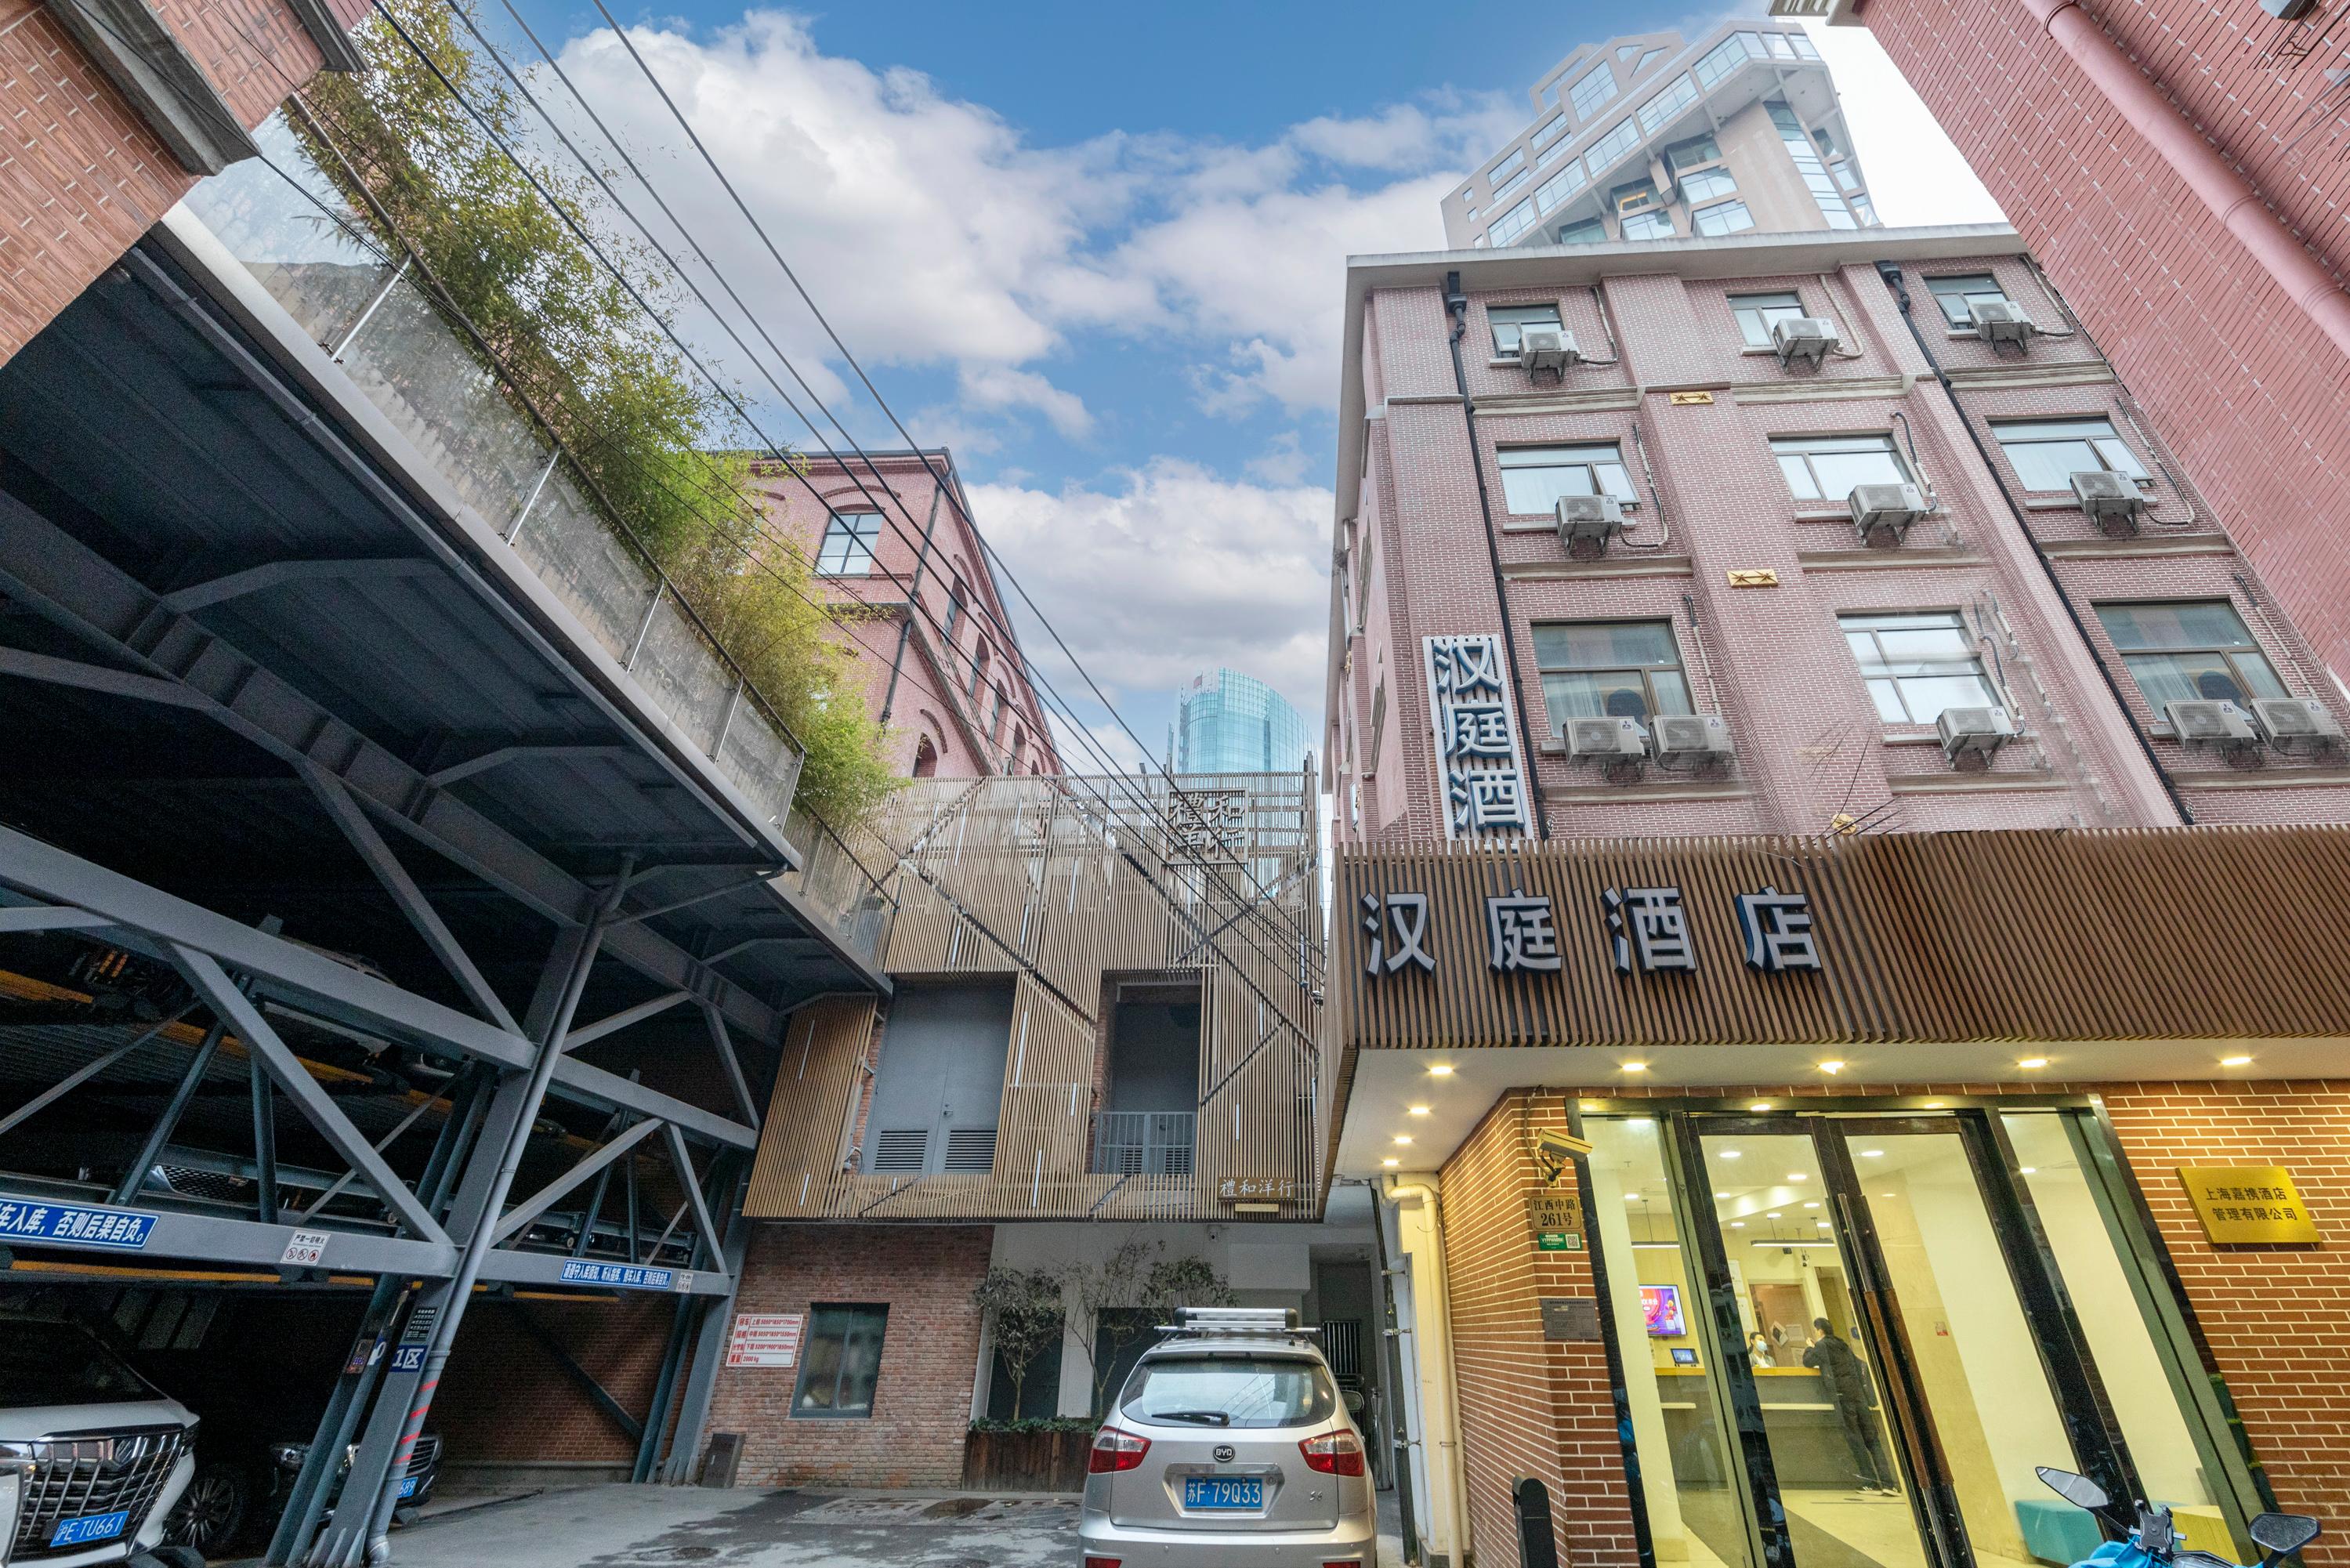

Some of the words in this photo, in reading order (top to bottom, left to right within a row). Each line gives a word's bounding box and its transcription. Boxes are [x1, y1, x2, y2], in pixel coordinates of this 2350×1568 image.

[1432, 639, 1526, 853] 汉庭酒
[1360, 885, 1822, 977] 汉庭酒店
[1219, 1178, 1294, 1197] 禮和洋行
[2206, 1187, 2287, 1201] 上海嘉携酒店
[1533, 1198, 1576, 1211] 江西中路
[0, 1204, 144, 1243] 车入库,否则后果自负。
[1541, 1212, 1573, 1226] 261号
[2212, 1208, 2297, 1221] 管理有限公司
[392, 1348, 424, 1369] 1区
